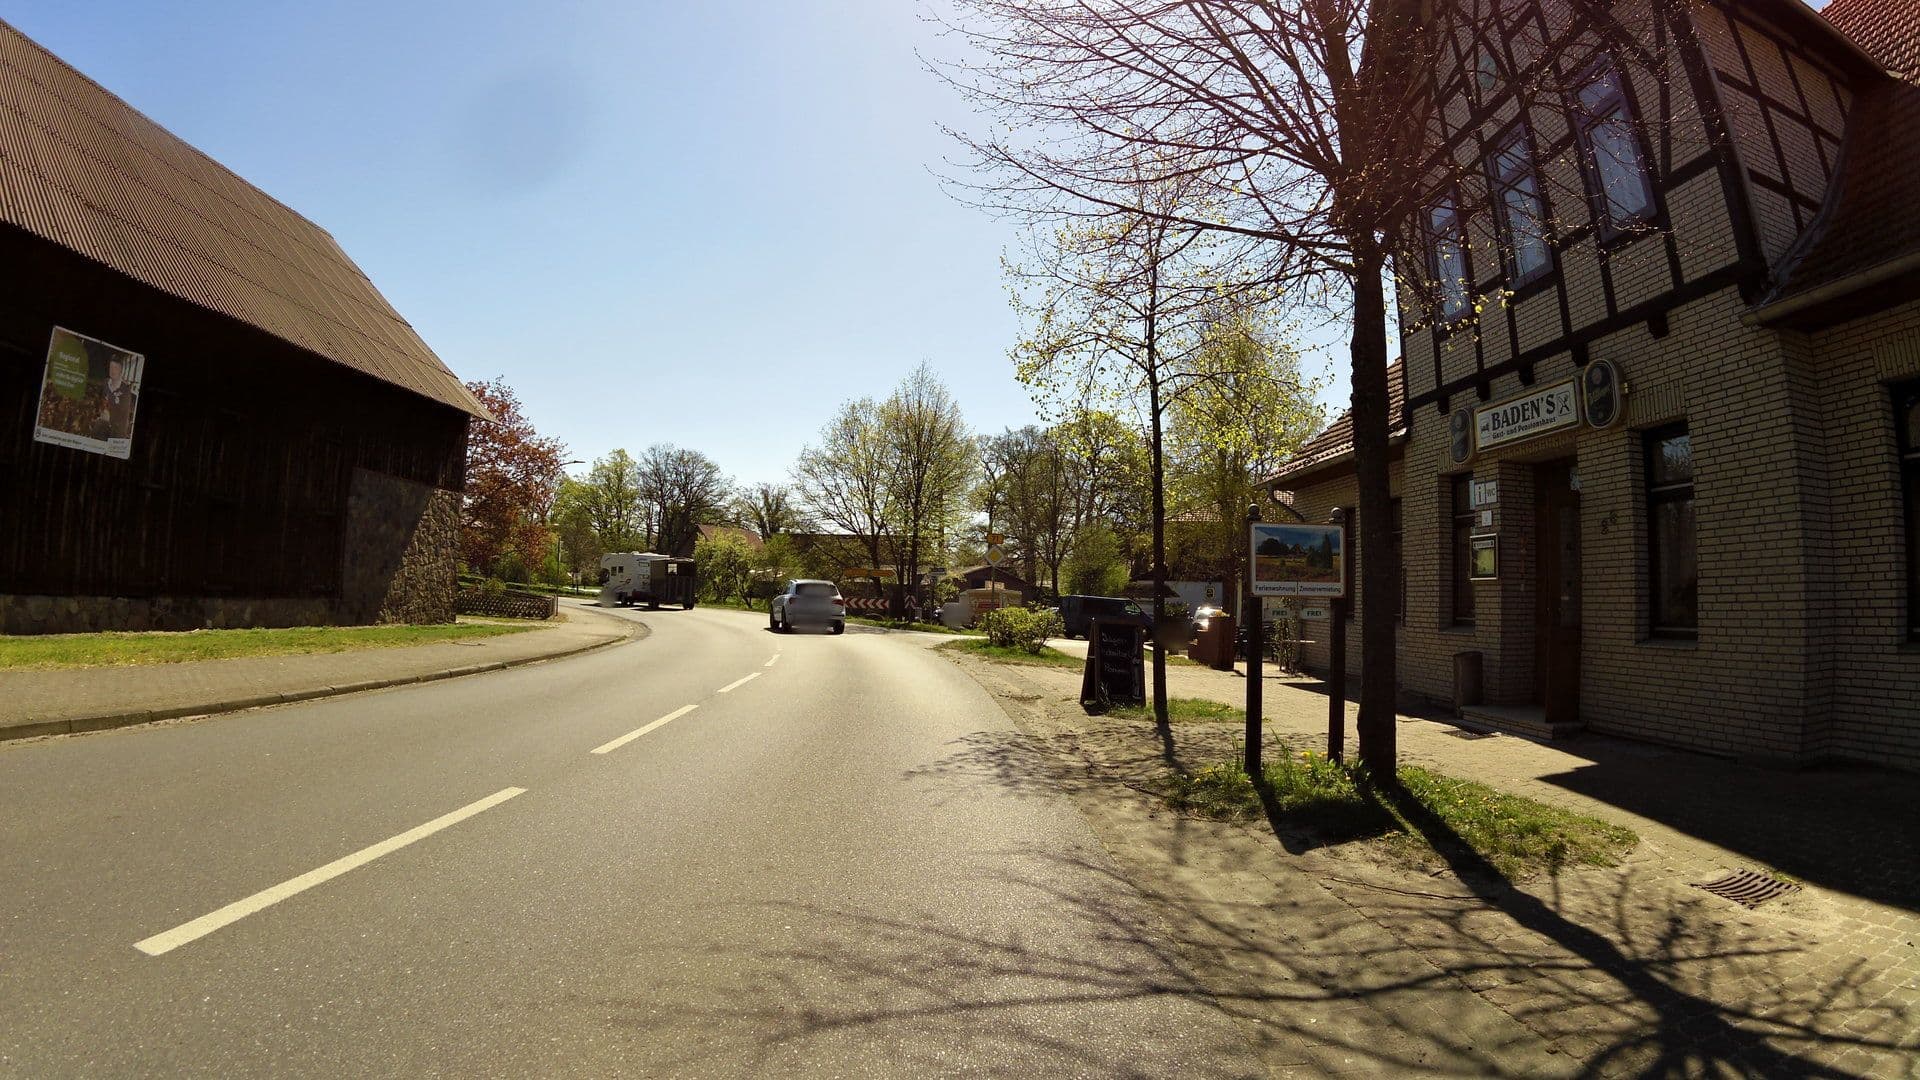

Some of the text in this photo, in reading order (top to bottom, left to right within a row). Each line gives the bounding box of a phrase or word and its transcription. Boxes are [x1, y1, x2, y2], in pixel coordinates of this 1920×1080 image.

[1491, 394, 1556, 431] BADEN'S
[1486, 488, 1496, 497] WC
[1271, 609, 1288, 617] FREI
